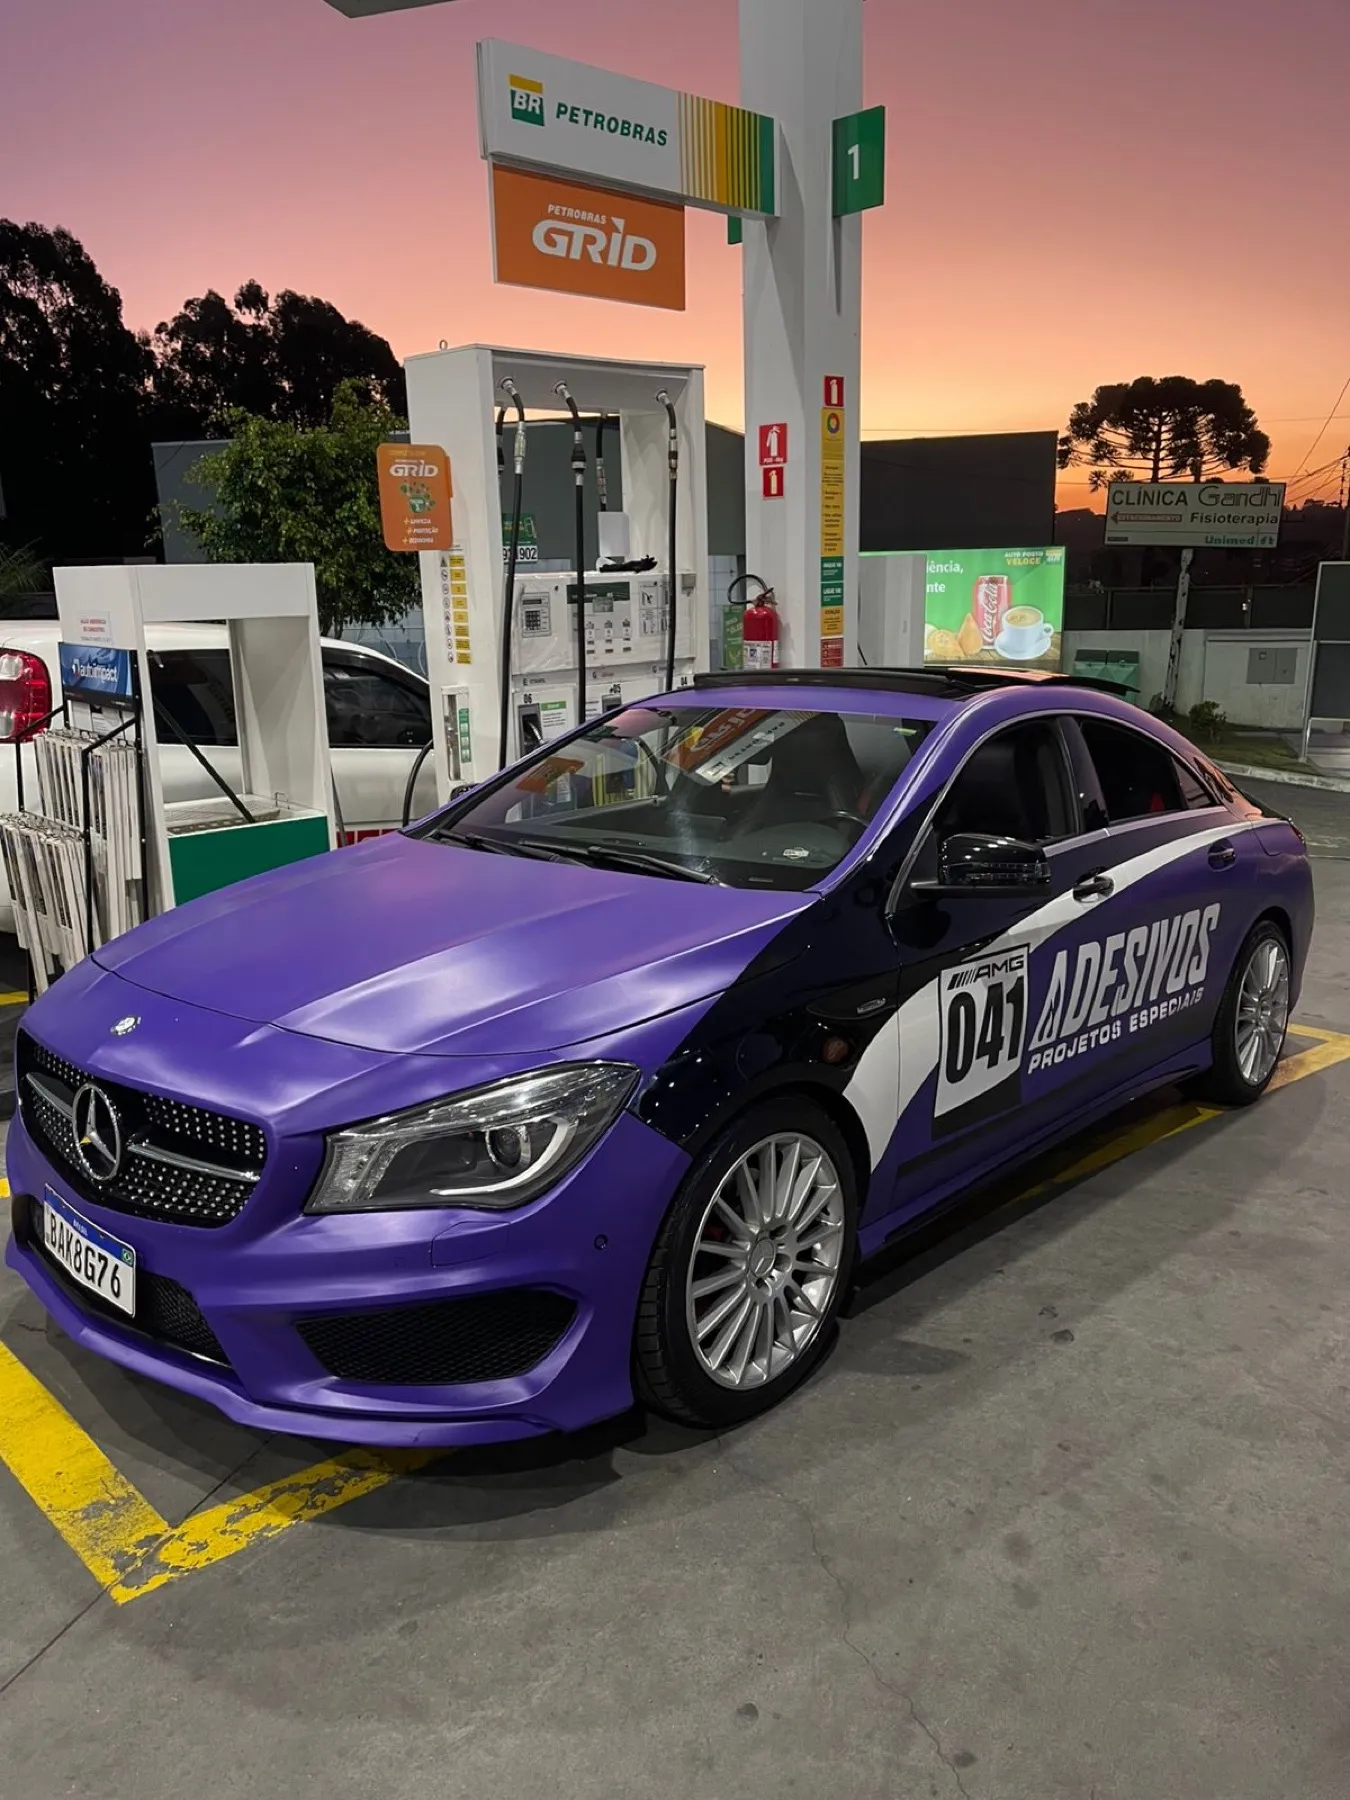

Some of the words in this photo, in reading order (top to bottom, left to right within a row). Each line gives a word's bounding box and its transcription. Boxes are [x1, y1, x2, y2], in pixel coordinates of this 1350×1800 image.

[512, 89, 543, 116] BR
[555, 102, 668, 147] PETROBRAS
[847, 144, 861, 180] 1
[548, 203, 607, 225] PETROBRAS
[532, 217, 657, 271] GRID
[389, 459, 439, 477] GRID
[1112, 486, 1188, 507] CLÍNICA
[1198, 485, 1283, 507] Gandhi
[1190, 512, 1278, 526] Fisioterapia
[1205, 535, 1255, 545] Unimed
[1006, 557, 1041, 566] VELOCE
[974, 954, 1025, 982] AMG
[1028, 903, 1221, 1052] ADESIVOS
[946, 976, 1025, 1085] 041
[1027, 1021, 1122, 1074] PROJETOS
[1129, 987, 1205, 1033] ESPECIAIS
[50, 1212, 122, 1299] BAK8G76
